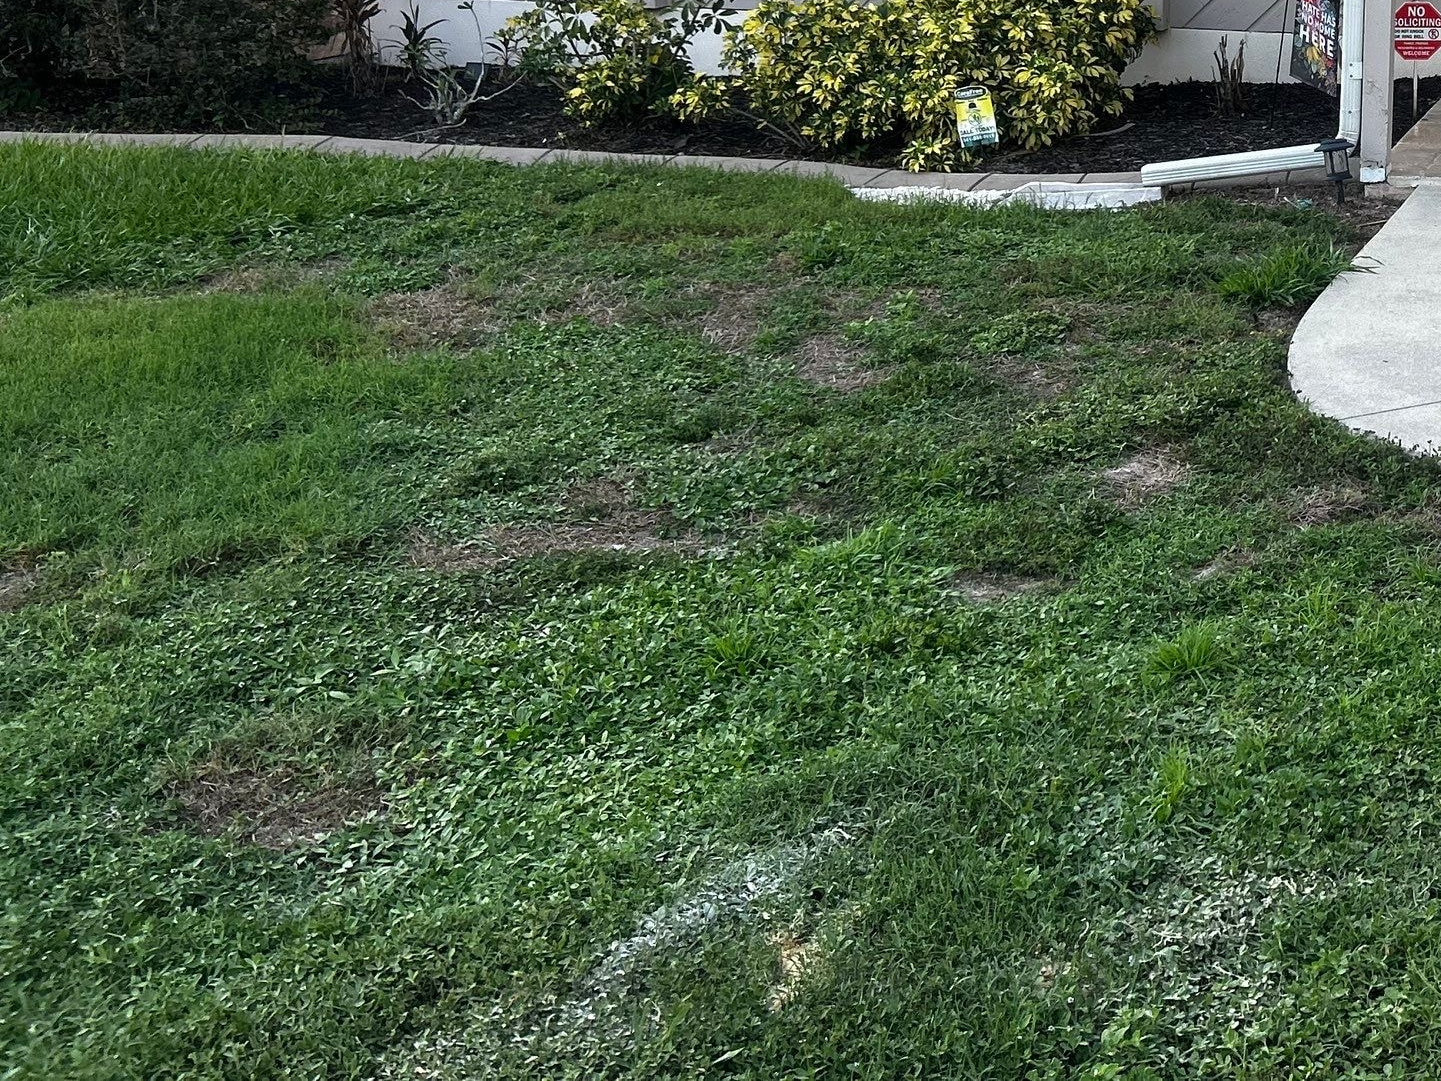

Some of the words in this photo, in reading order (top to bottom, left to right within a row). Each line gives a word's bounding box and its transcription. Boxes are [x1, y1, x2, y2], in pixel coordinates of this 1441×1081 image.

[1301, 0, 1320, 19] HATE
[1321, 12, 1336, 28] HAS
[1395, 17, 1441, 27] SOLICITING
[1407, 6, 1426, 17] NO
[1301, 12, 1314, 26] NO
[1314, 20, 1336, 40] HOME
[1300, 24, 1334, 58] HERE
